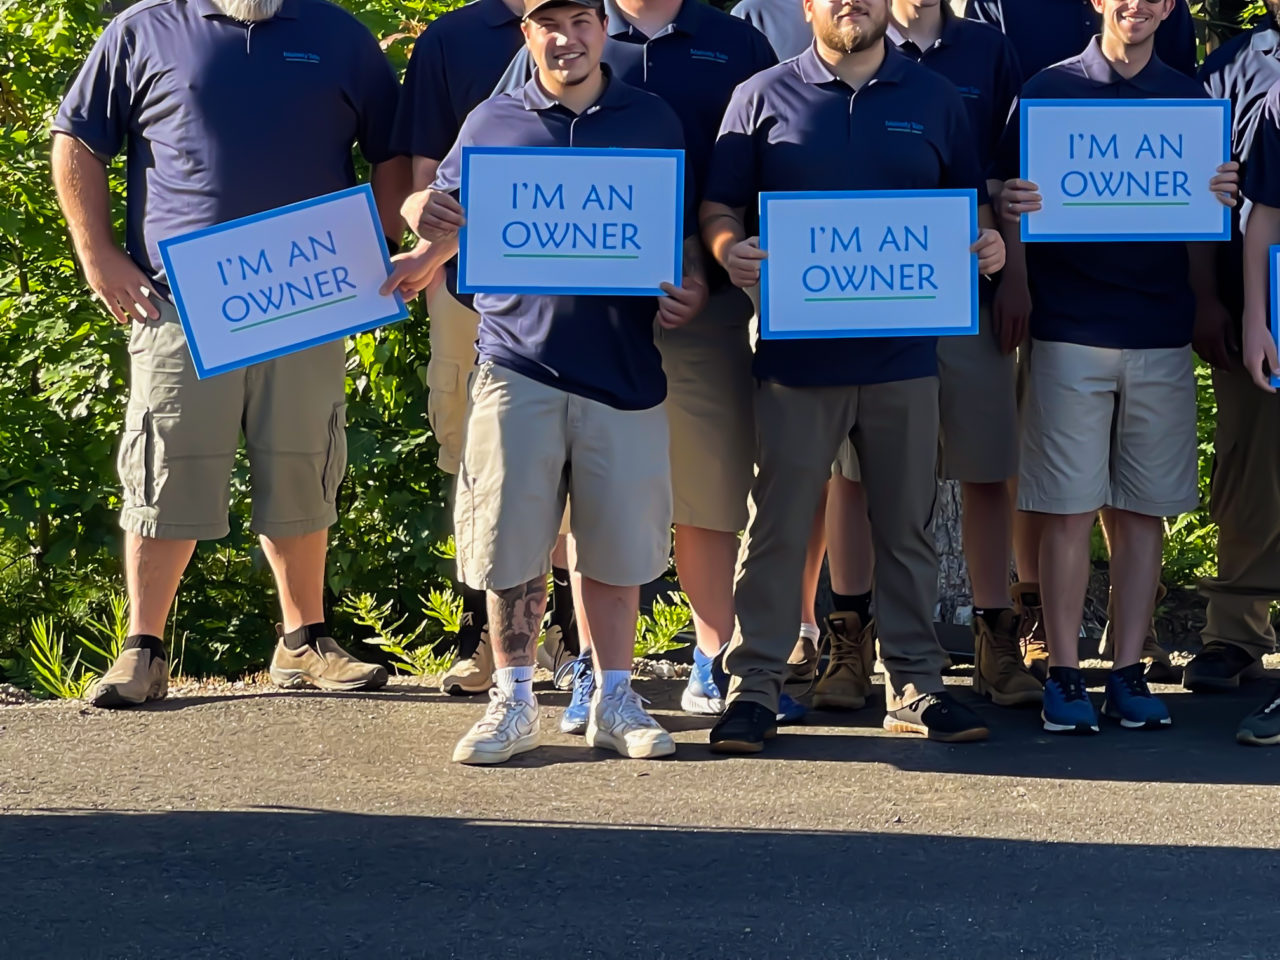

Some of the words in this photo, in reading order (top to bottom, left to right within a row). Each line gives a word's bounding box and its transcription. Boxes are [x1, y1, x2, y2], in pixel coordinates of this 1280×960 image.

[1068, 133, 1120, 160] I'M
[1134, 133, 1183, 160] AN
[512, 182, 566, 211] I'M
[581, 183, 633, 212] AN
[1060, 170, 1193, 198] OWNER
[501, 220, 642, 251] OWNER
[809, 225, 863, 254] I'M
[878, 224, 929, 253] AN
[217, 249, 273, 286] I'M
[289, 230, 337, 268] AN
[801, 263, 939, 294] OWNER
[221, 266, 357, 323] OWNER
